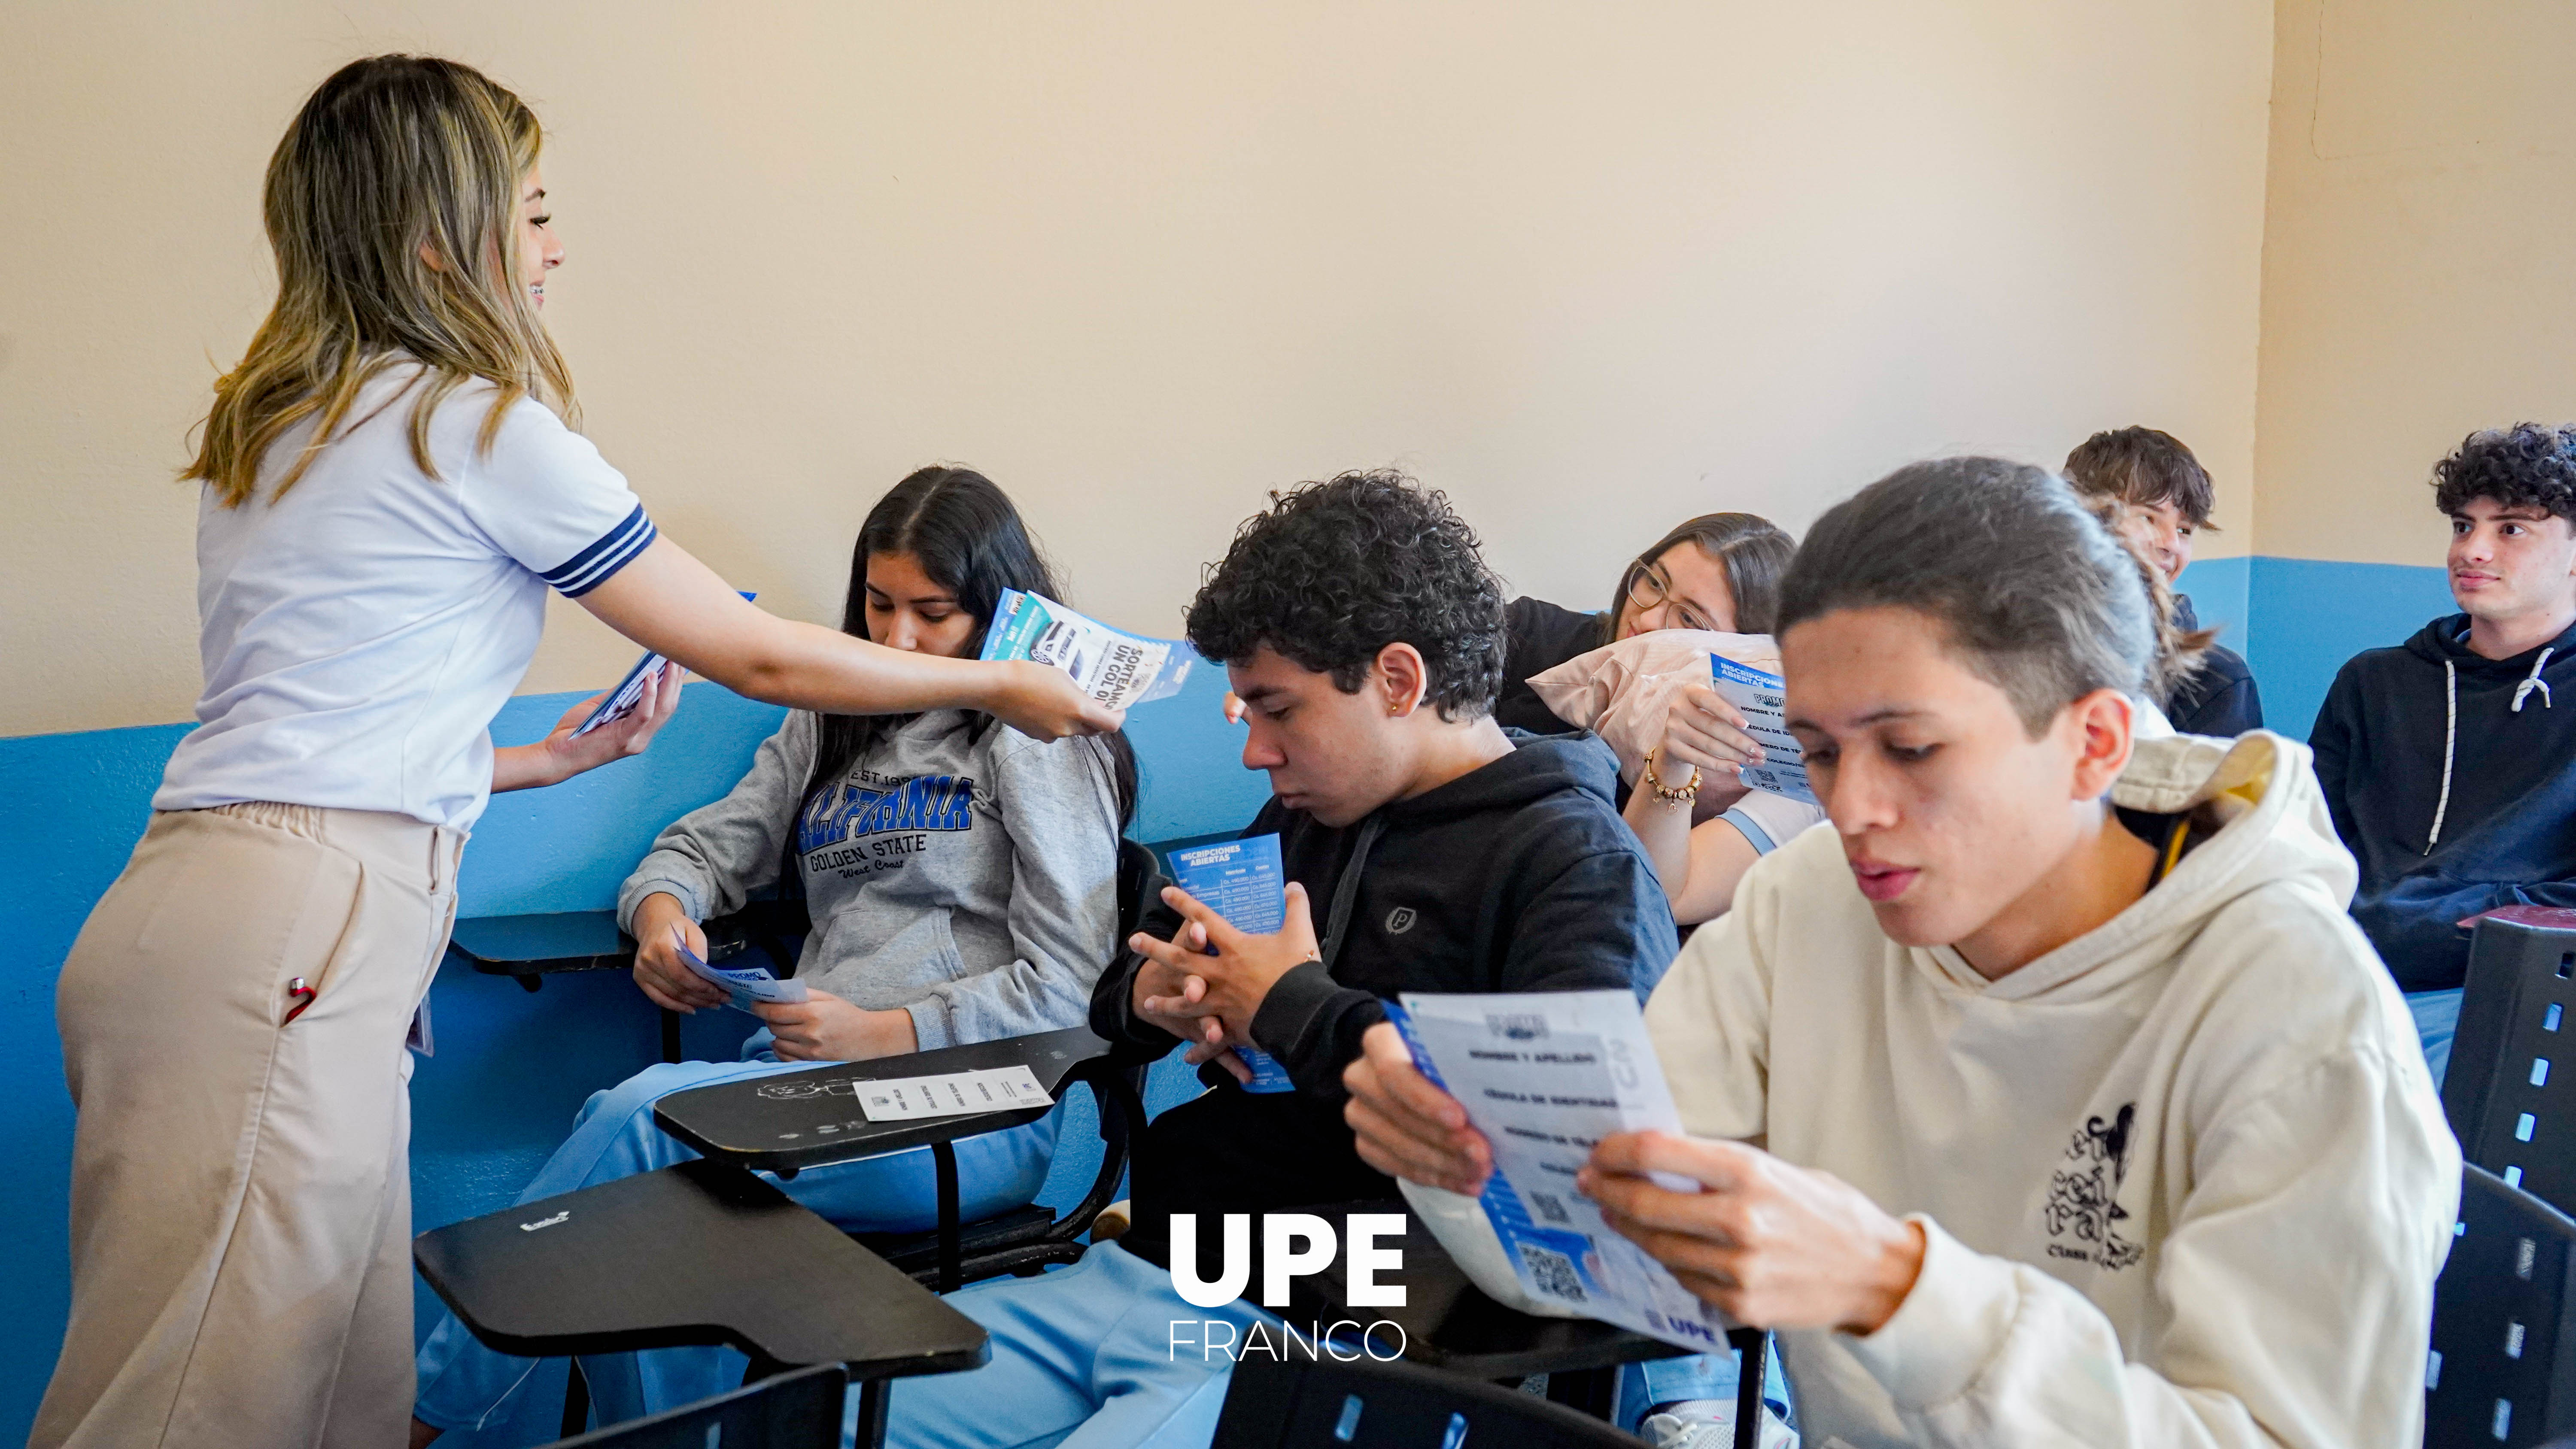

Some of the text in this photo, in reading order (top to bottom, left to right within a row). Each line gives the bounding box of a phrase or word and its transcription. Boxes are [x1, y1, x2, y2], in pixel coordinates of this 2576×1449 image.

[1113, 645, 1130, 662] UN
[1721, 669, 1765, 688] ABIERTAS
[1741, 706, 1769, 715] NOMBRE
[1747, 724, 1771, 732] ÉDULA
[1758, 741, 1779, 750] MERO
[810, 834, 927, 872] GOLDEN STATE
[1181, 845, 1241, 861] INSCRIPCIONES
[1191, 854, 1230, 867] ABIERTAS
[838, 858, 905, 879] West Coast
